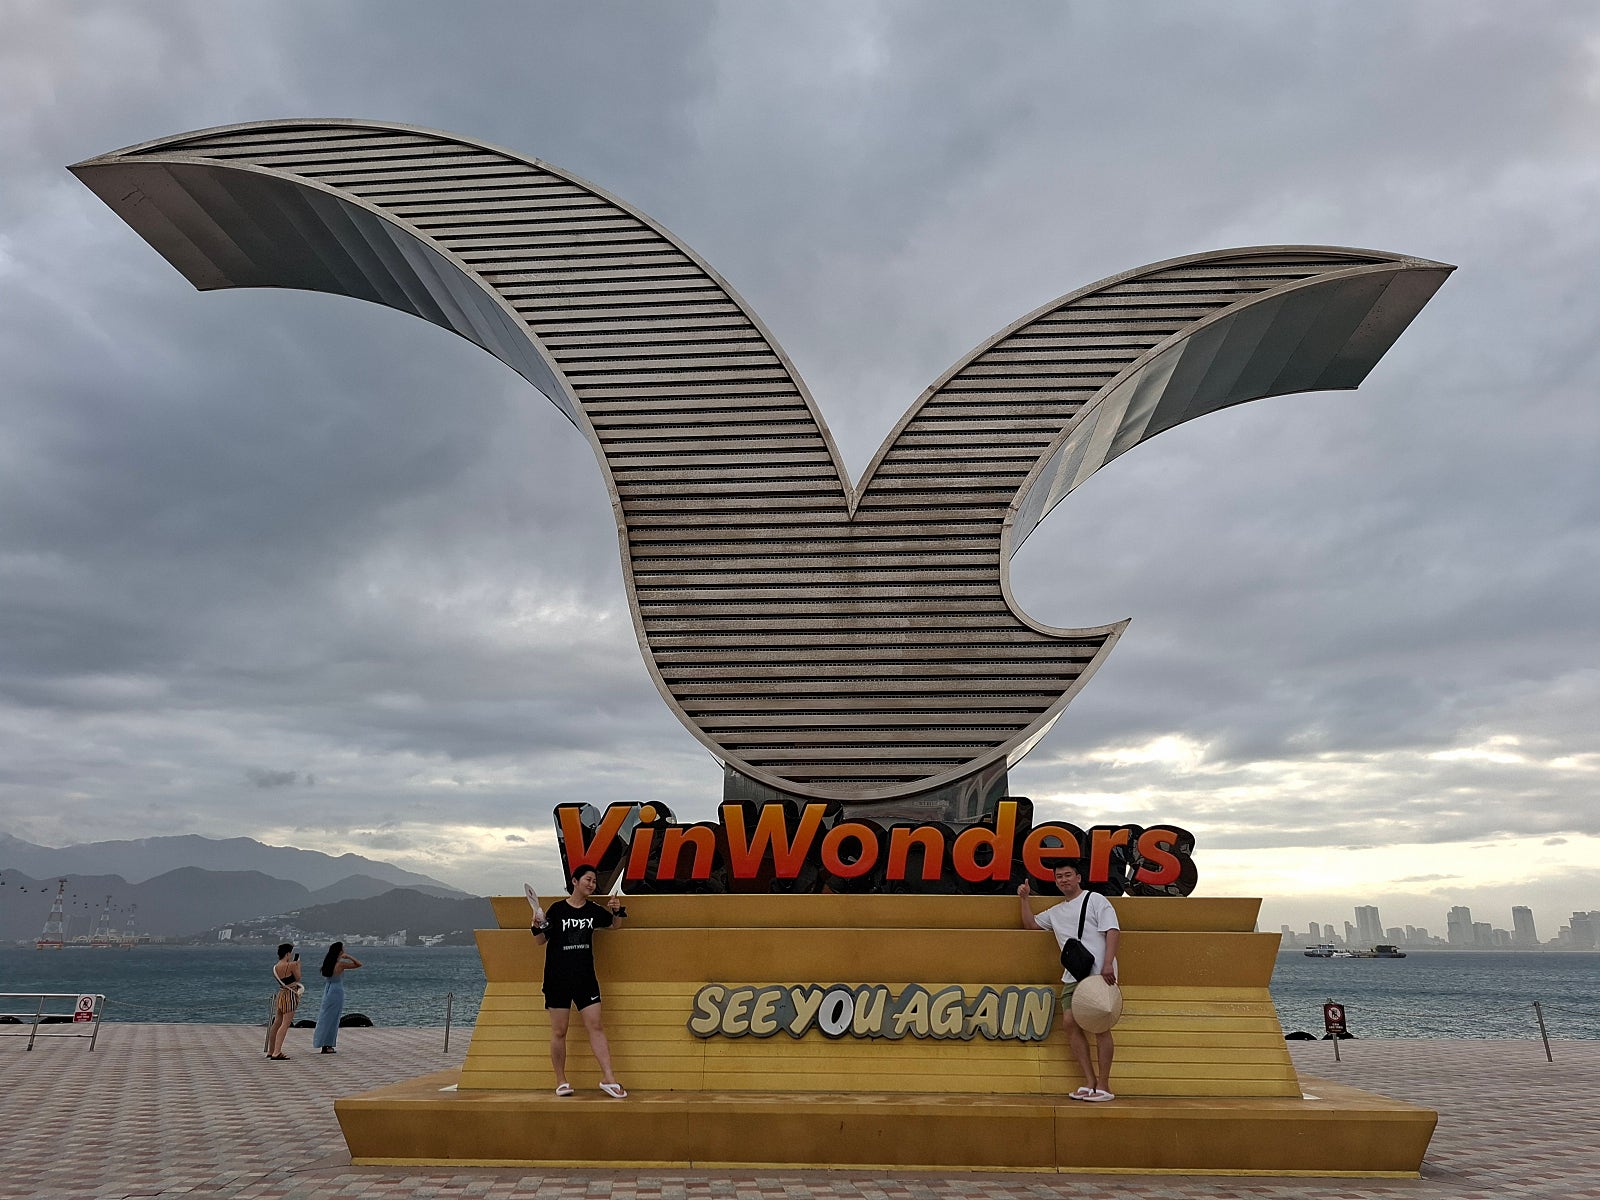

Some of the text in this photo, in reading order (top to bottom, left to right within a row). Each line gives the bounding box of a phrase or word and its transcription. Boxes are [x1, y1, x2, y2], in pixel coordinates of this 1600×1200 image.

[558, 801, 1182, 885] VinWonders
[691, 985, 1051, 1037] SEE YOU AGAIN
